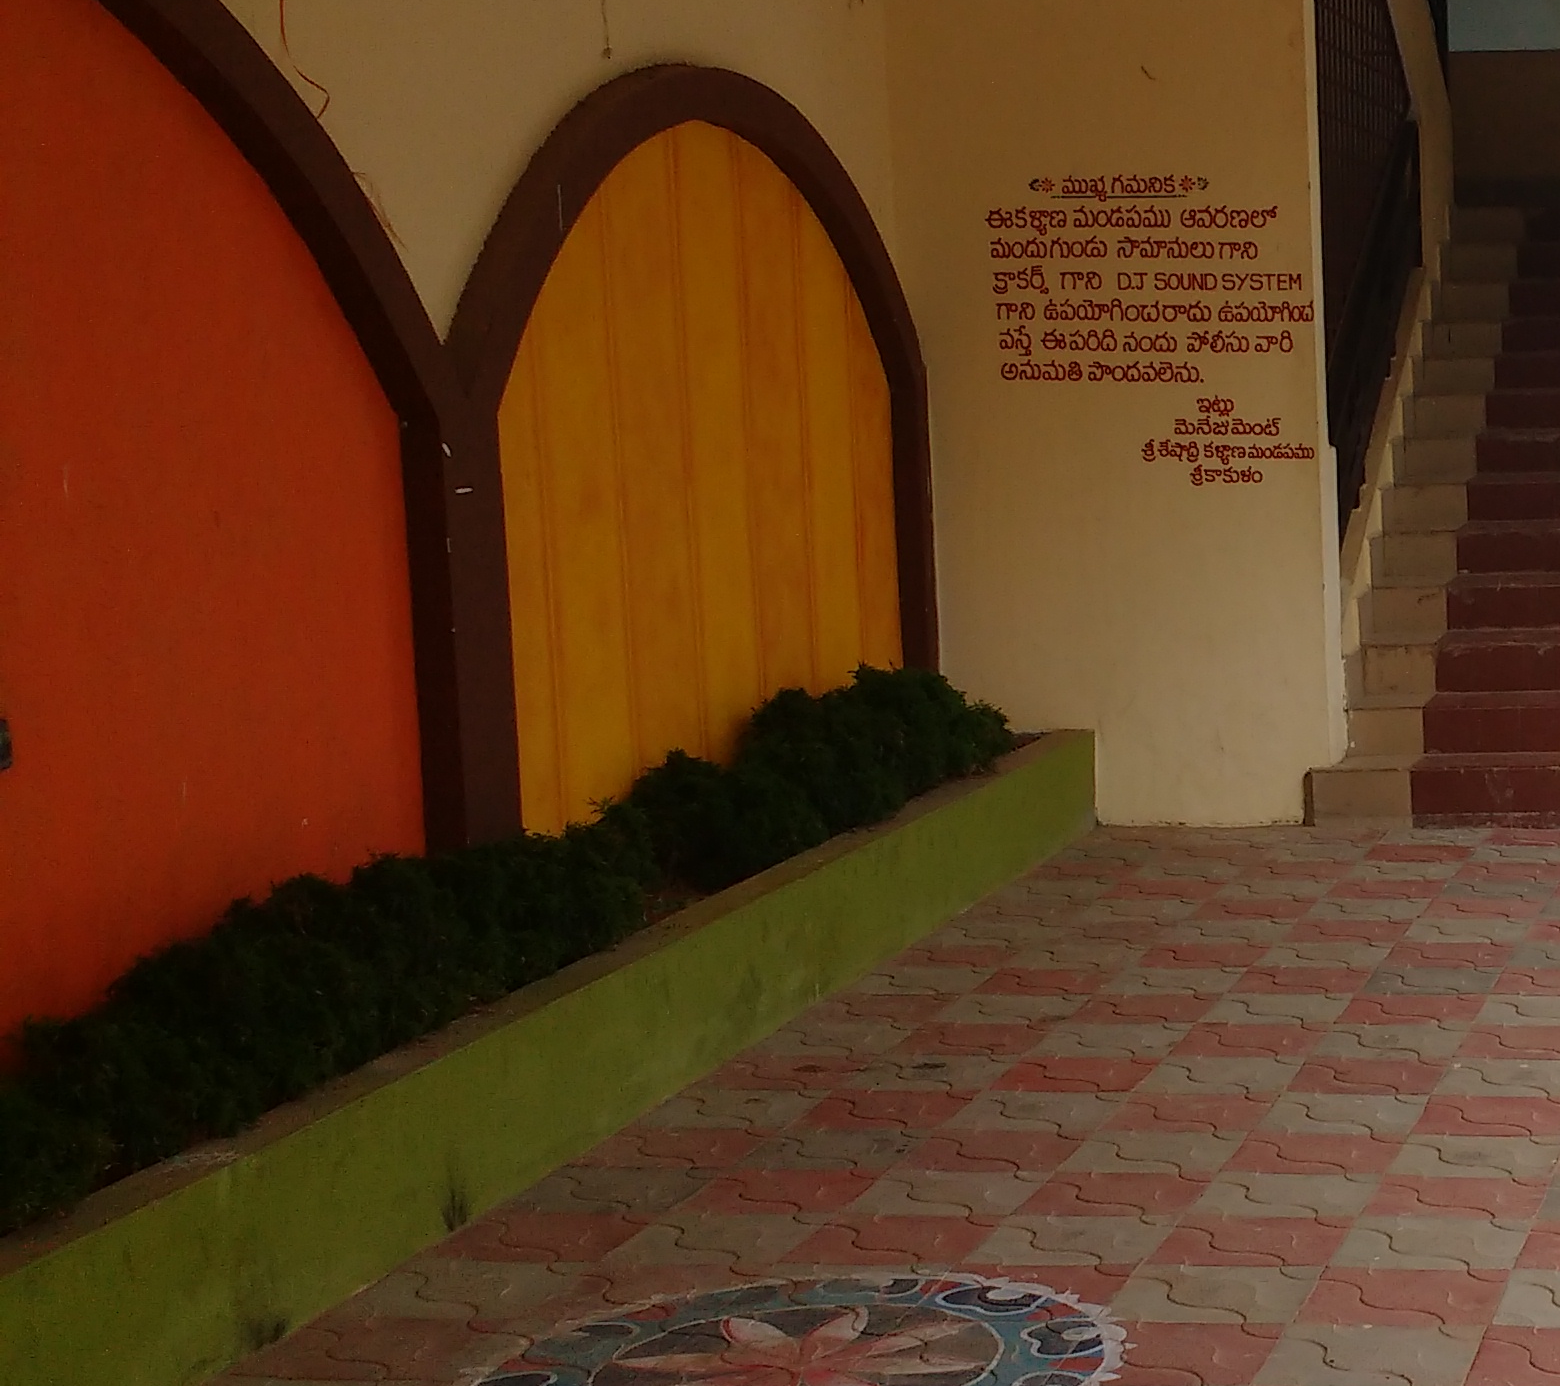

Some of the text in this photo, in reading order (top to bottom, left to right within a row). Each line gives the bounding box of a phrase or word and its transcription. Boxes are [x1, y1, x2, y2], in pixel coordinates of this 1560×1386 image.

[1111, 174, 1175, 194] గమనిక
[1073, 205, 1171, 228] మండపము
[1180, 205, 1278, 228] ఆవరణలో
[1117, 236, 1214, 259] సామానులు
[1218, 241, 1258, 260] గాని
[1060, 271, 1102, 290] గాని
[1154, 272, 1218, 291] SOUND
[1222, 273, 1302, 291] SYSTEM
[996, 302, 1035, 320] గాని
[1123, 331, 1177, 353] నందు
[1187, 330, 1249, 353] పోలీసు
[1254, 330, 1293, 353] వారి
[1001, 359, 1083, 381] అనుమతి
[1141, 439, 1156, 462] శ్రీ
[1248, 443, 1315, 459] మండపము
